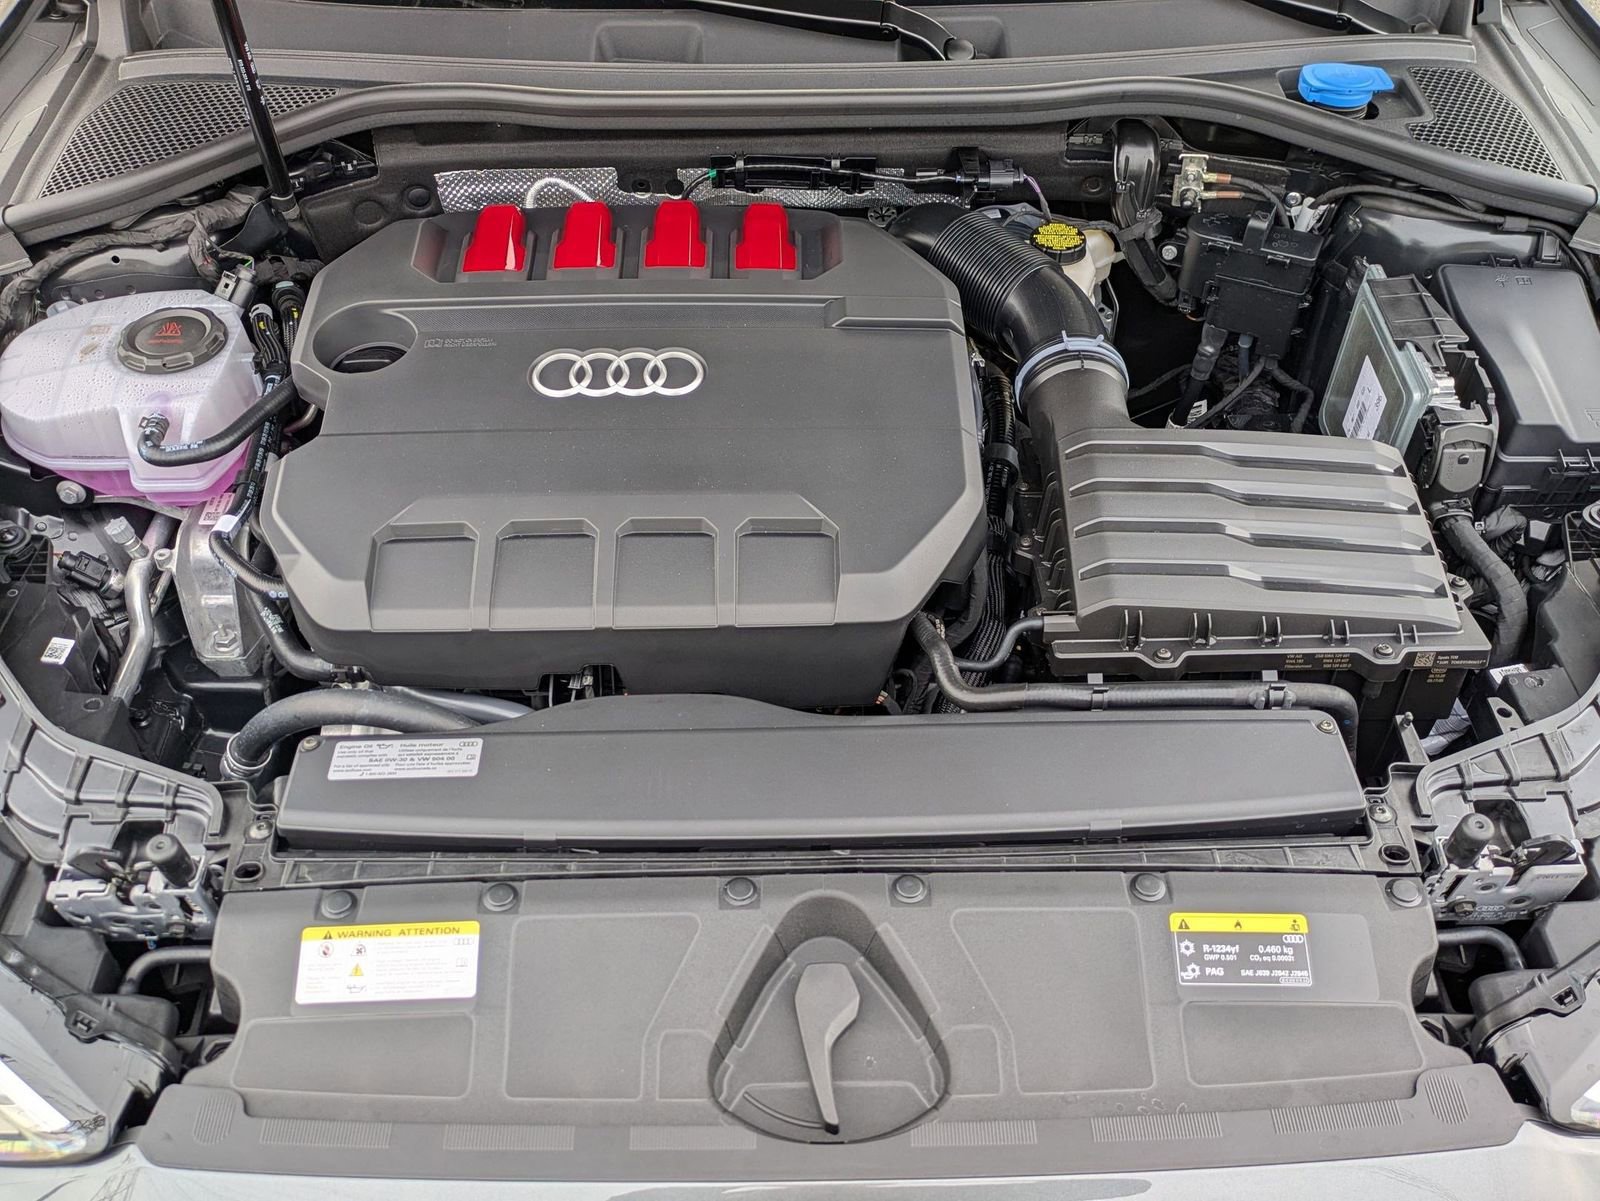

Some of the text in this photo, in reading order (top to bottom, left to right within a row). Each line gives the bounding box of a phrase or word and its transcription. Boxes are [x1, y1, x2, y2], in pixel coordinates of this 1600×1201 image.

[337, 927, 460, 939] WARNING ATTENTION
[1202, 944, 1240, 954] R-1234yf
[1258, 945, 1293, 955] 0.460 kg
[1205, 967, 1225, 976] PAG
